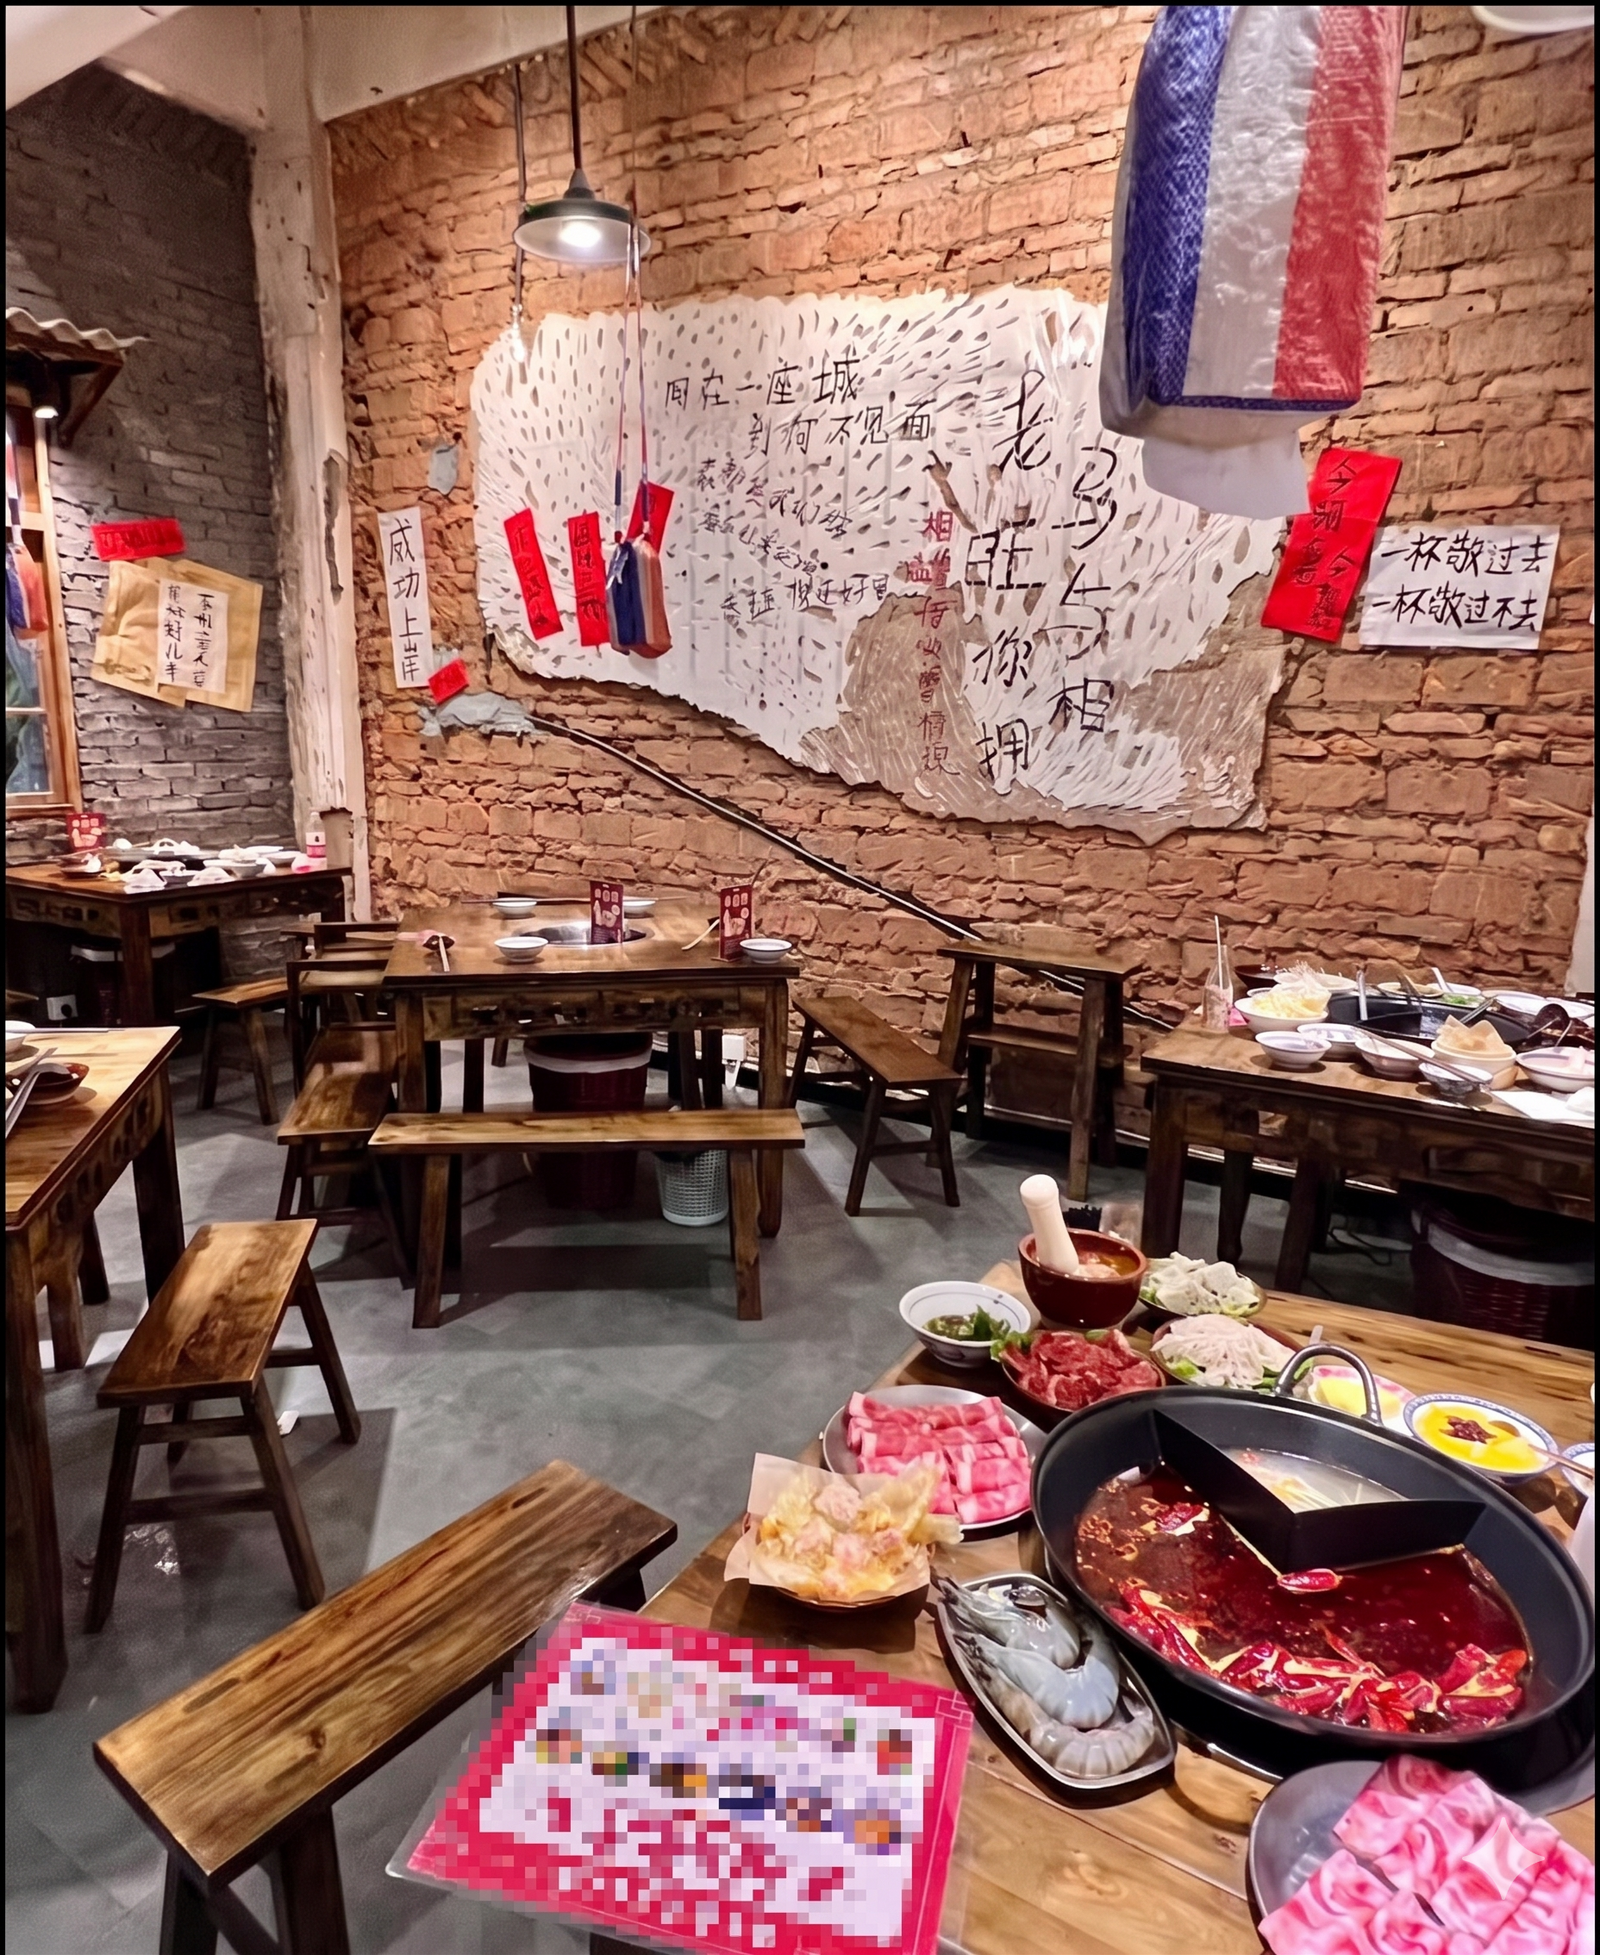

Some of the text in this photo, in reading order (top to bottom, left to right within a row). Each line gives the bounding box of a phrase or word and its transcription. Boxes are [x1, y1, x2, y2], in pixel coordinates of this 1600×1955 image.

[1381, 530, 1555, 577] 一杯敬过去
[1371, 581, 1541, 631] 一杯敬过不去
